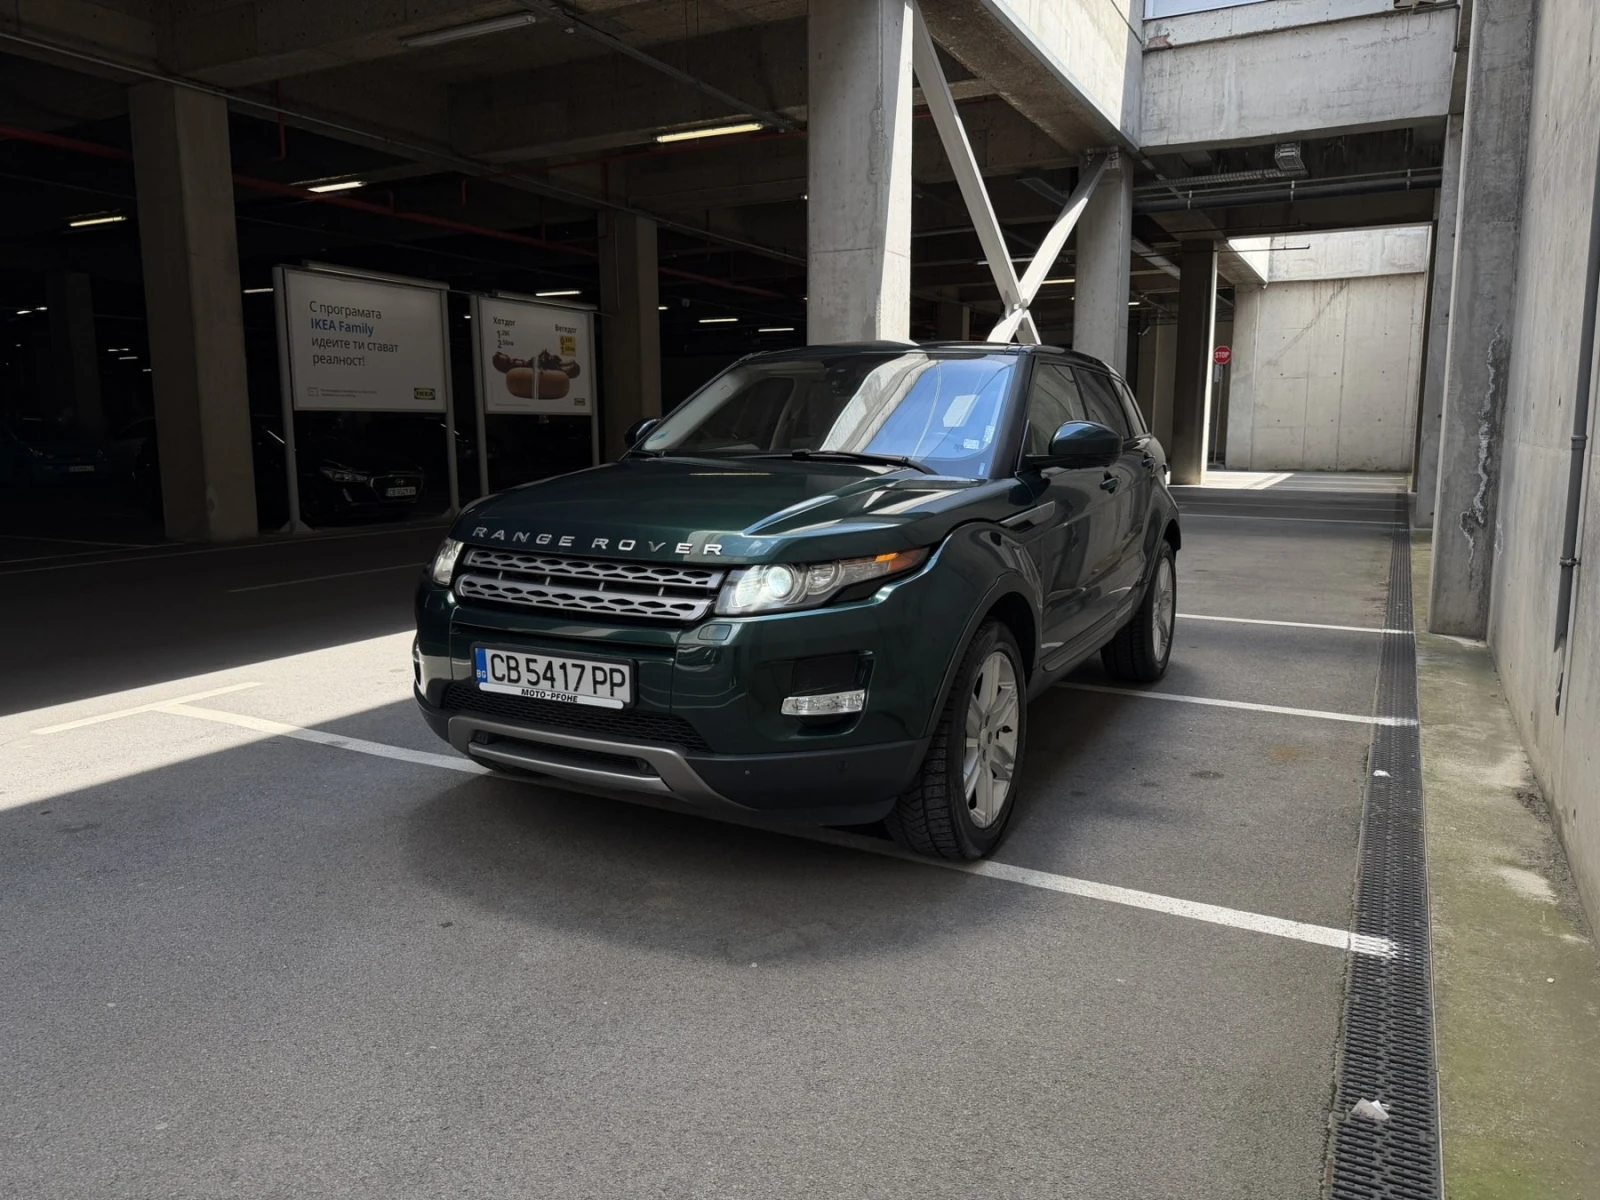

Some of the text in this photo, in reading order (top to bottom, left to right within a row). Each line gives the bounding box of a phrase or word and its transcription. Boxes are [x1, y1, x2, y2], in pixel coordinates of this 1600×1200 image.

[320, 304, 382, 320] програмата
[311, 318, 374, 337] IKEA Family
[493, 317, 516, 327] Хотдог
[312, 338, 399, 352] идеите ти стават
[313, 354, 366, 367] реалност!
[1215, 351, 1230, 359] STOP
[416, 388, 434, 398] IKEA
[472, 526, 722, 555] RANGE ROVER
[476, 669, 487, 679] BG
[521, 688, 578, 703] MOTO-PFOHE
